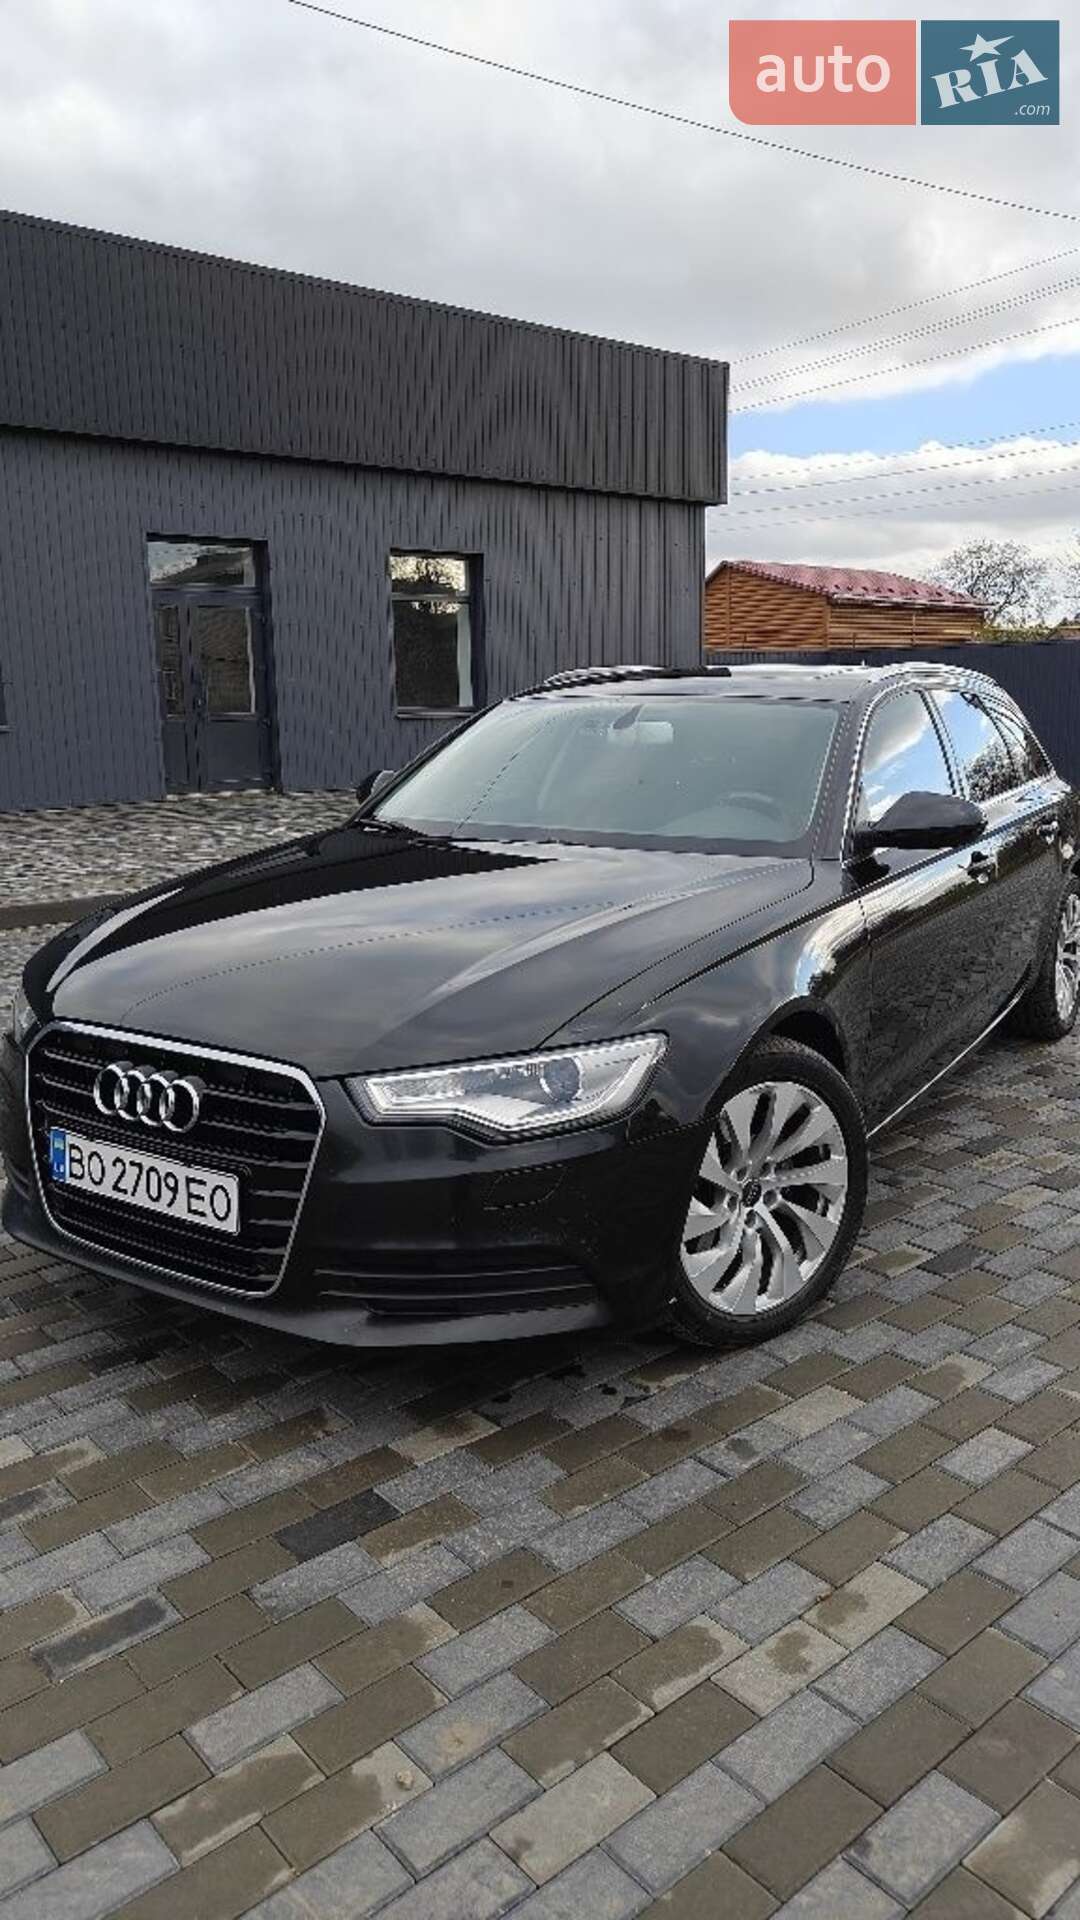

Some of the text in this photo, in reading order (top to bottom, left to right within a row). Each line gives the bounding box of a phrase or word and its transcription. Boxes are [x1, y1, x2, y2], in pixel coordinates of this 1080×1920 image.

[68, 1143, 232, 1222] BO 2709 EO
